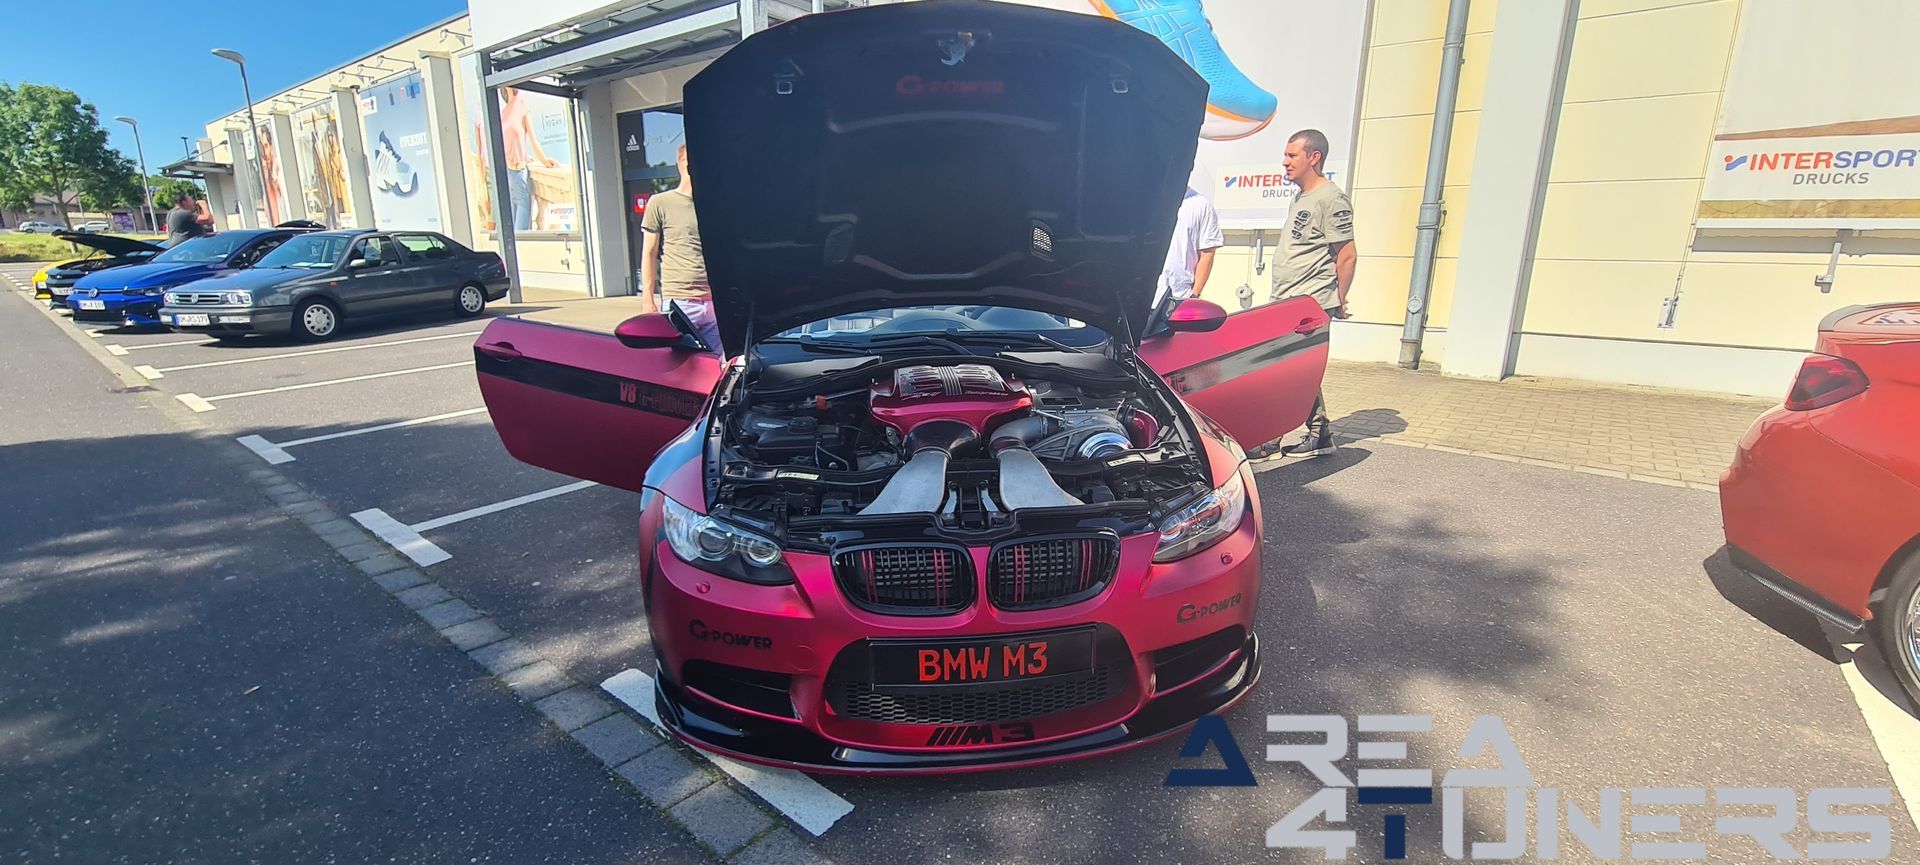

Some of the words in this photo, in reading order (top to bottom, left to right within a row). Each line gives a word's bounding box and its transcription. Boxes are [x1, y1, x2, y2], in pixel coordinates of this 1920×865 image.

[1749, 150, 1920, 171] INTERSPOR
[1793, 172, 1870, 185] DRUCKS
[1262, 188, 1299, 198] DRUCK
[620, 382, 637, 404] V8
[1176, 593, 1242, 624] G-POWER
[688, 619, 772, 649] G-POWER
[918, 646, 991, 682] BMW
[1003, 641, 1048, 677] M3
